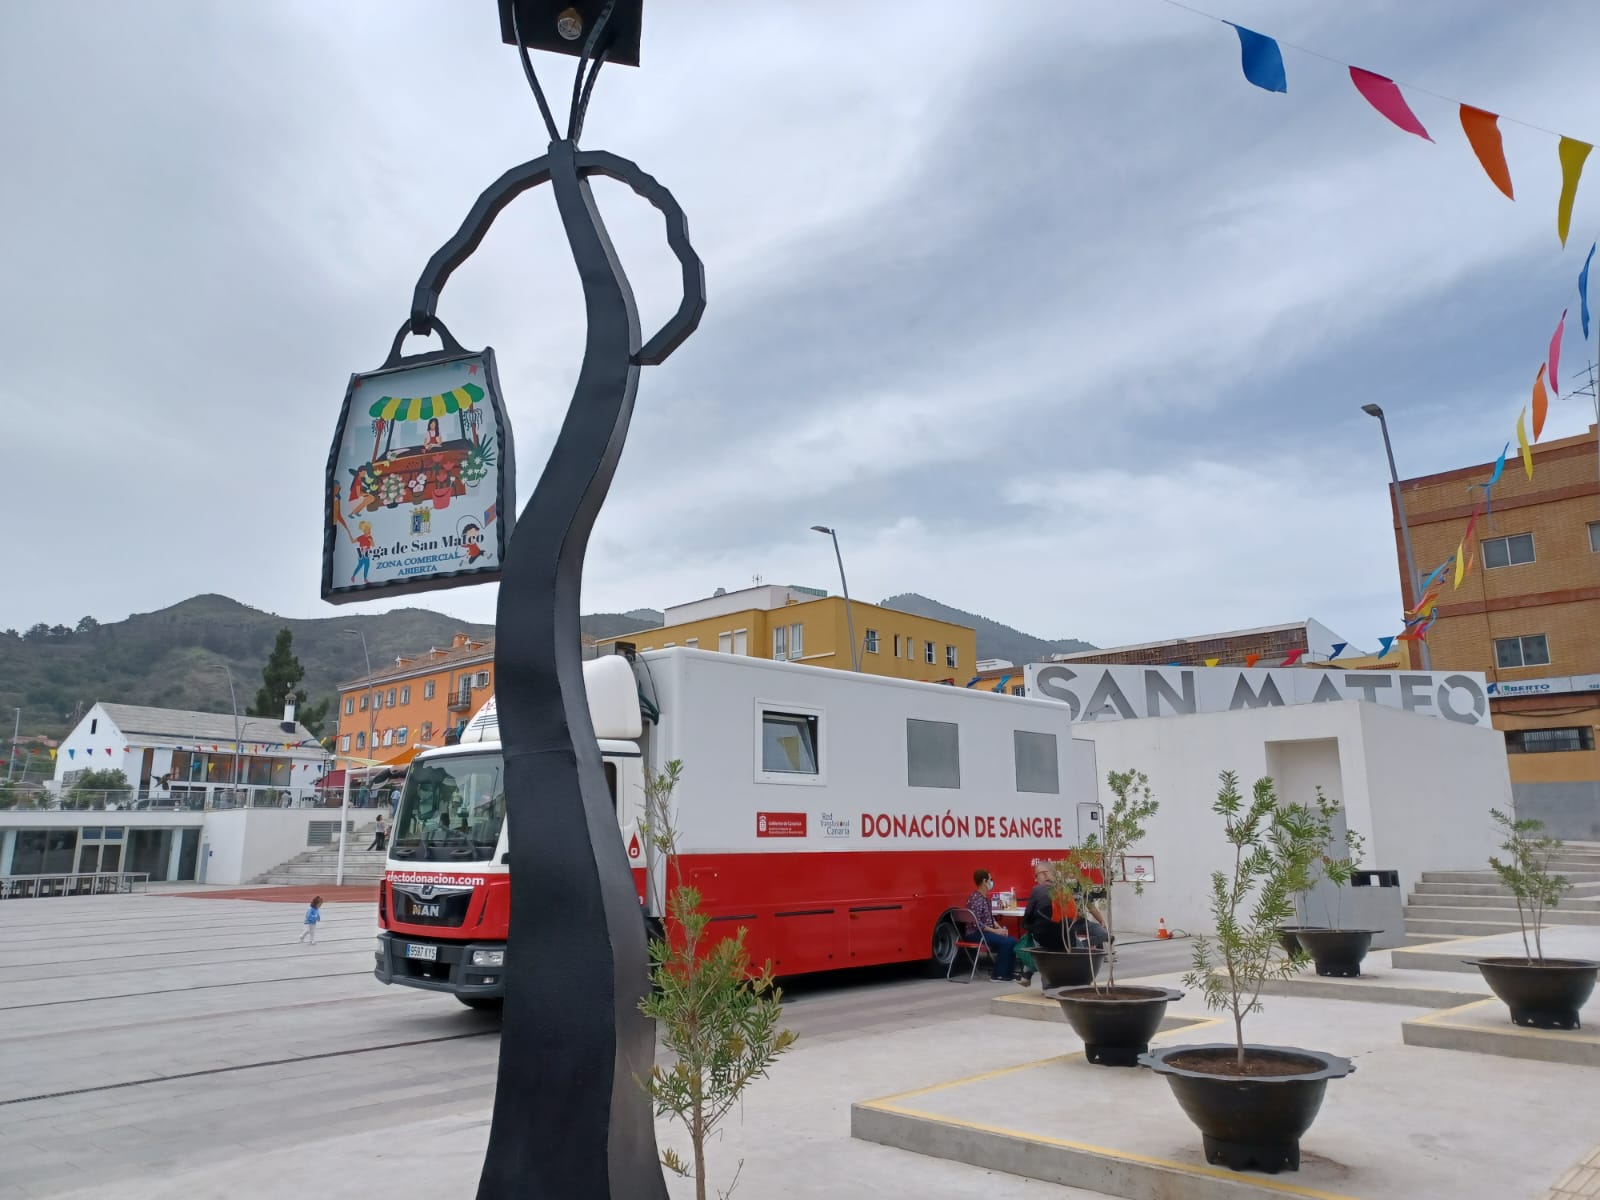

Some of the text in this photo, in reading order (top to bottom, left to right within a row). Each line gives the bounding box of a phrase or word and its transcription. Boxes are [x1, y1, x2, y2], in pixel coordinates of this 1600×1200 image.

[356, 533, 484, 560] Vega de San Mateo
[375, 551, 461, 570] ZONA COMERCIAL
[397, 564, 438, 576] ABIERTA
[1036, 665, 1198, 722] SAN
[861, 809, 1063, 838] DONACIÓN DE SANGRE
[386, 871, 484, 886] efectodonacion.com
[412, 904, 440, 917] MAN
